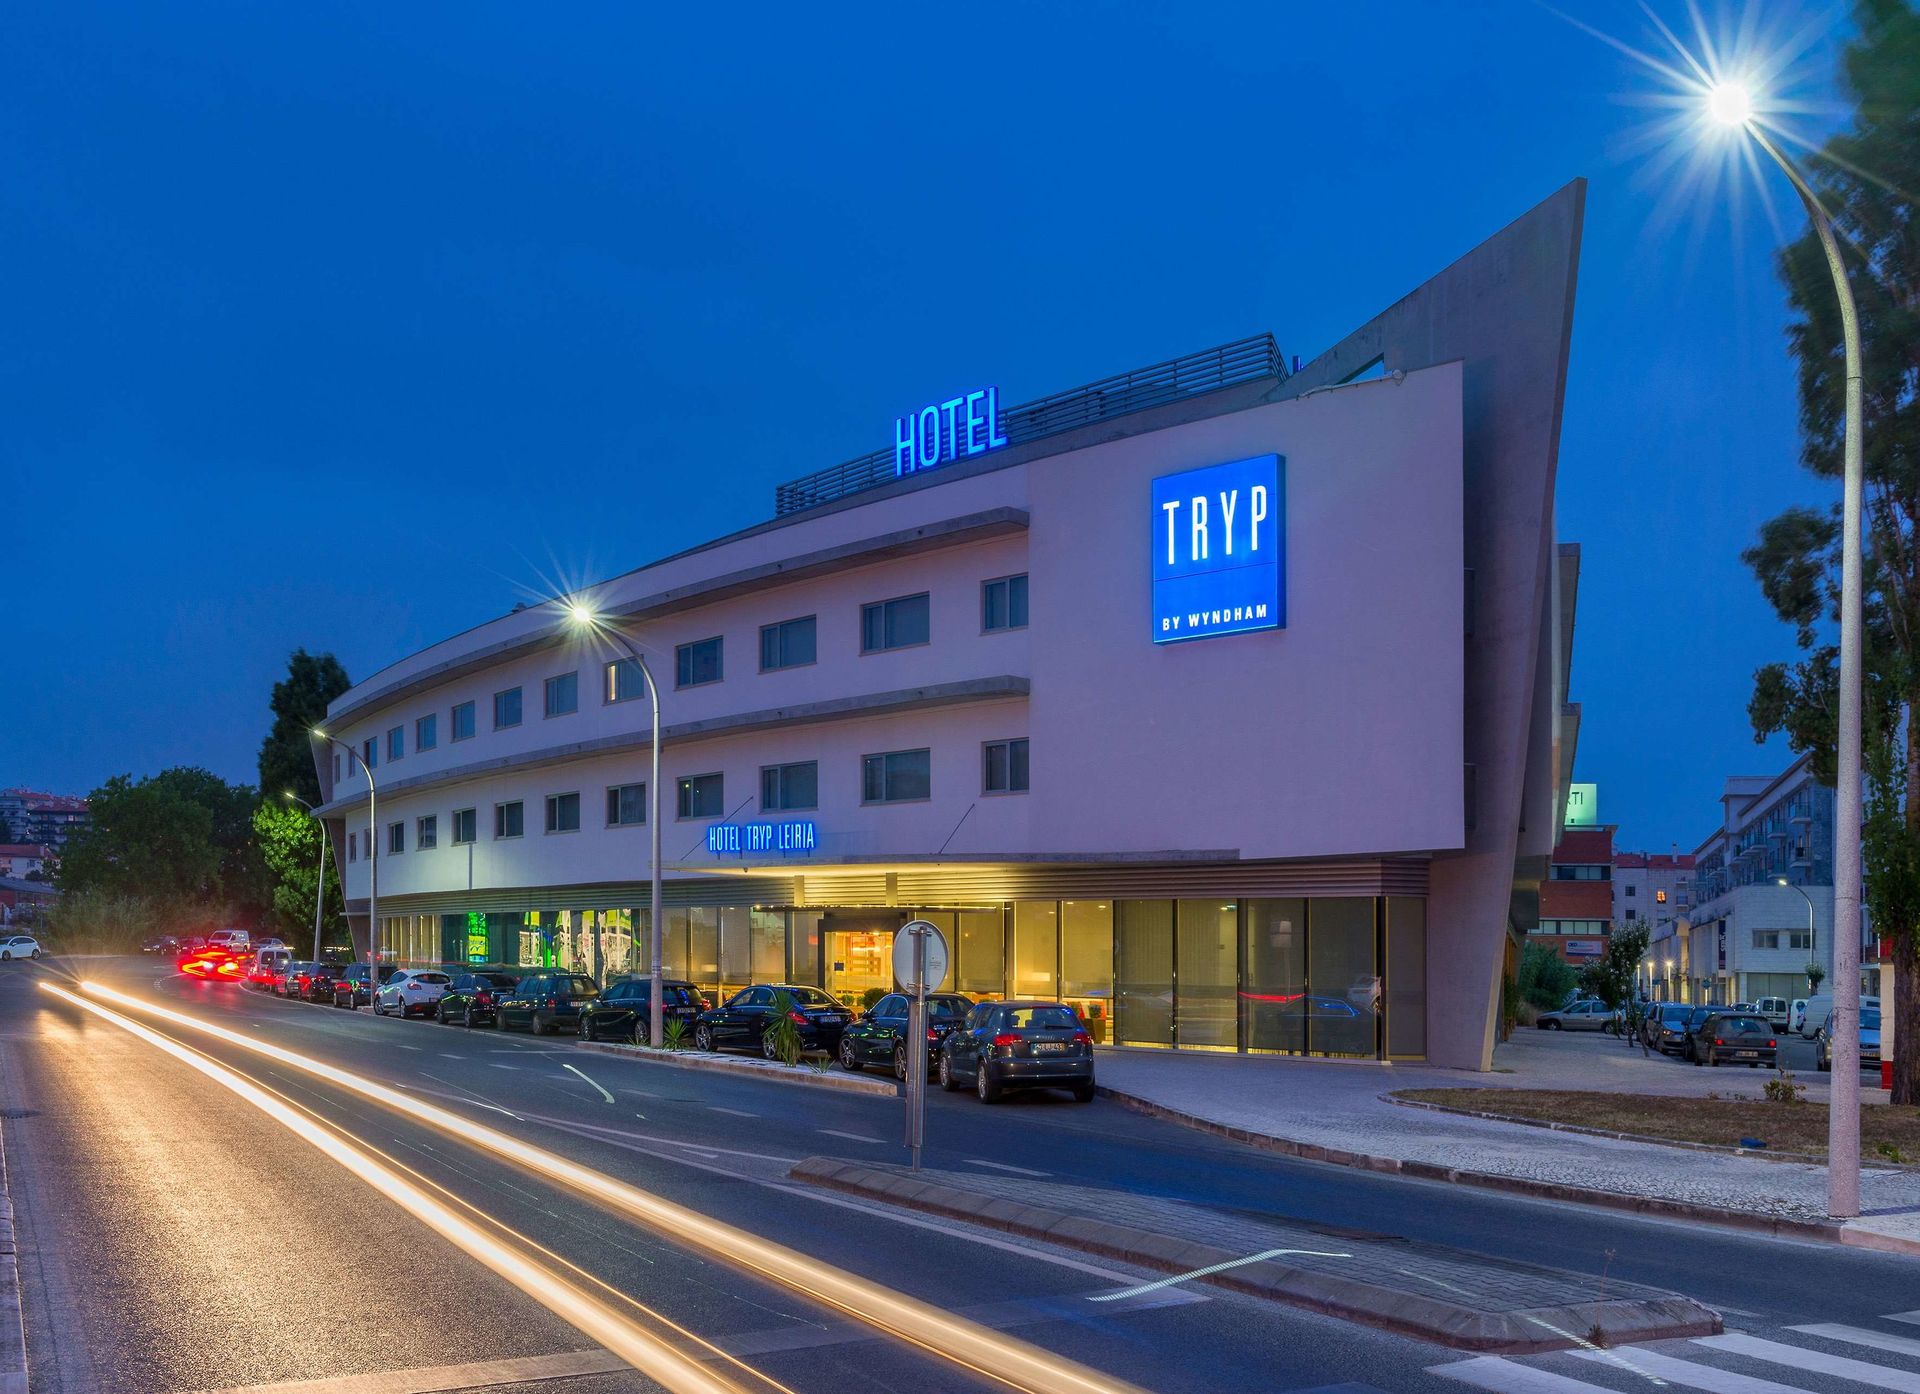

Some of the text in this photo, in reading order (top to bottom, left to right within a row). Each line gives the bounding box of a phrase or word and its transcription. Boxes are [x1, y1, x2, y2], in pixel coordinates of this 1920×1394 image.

[896, 386, 1008, 476] HOTEL
[1162, 485, 1267, 565] TRYP
[1162, 603, 1267, 631] BY WYNDHAM
[709, 823, 814, 851] HOTEL TRYP LEIRIA
